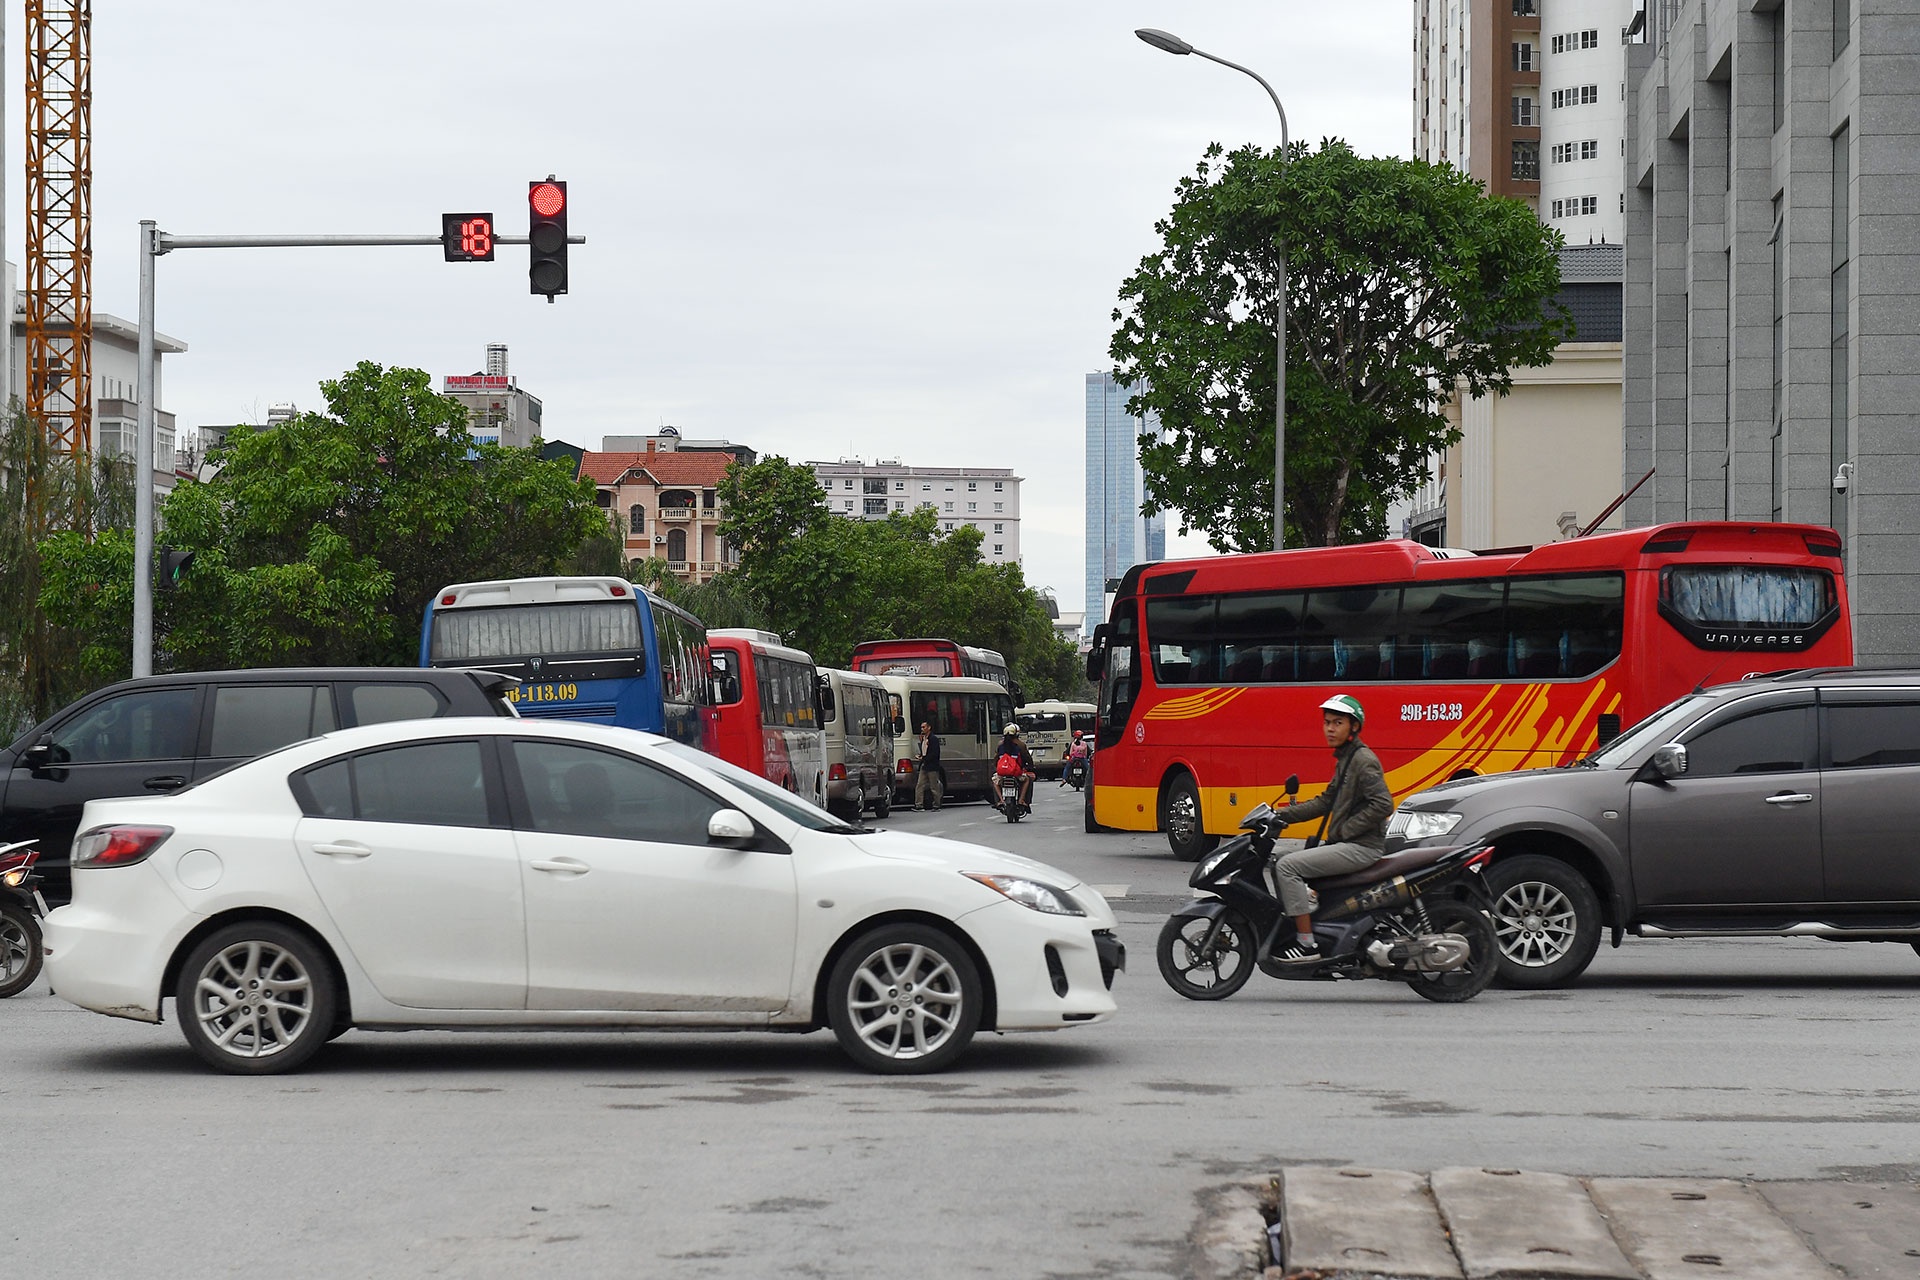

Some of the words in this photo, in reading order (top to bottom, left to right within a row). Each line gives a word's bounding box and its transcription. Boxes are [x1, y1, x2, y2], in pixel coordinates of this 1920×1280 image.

[462, 219, 490, 256] 18
[447, 376, 482, 384] APARTMENT
[484, 376, 495, 384] FOR
[1705, 633, 1803, 644] UNIVERSE
[504, 683, 578, 703] B-113.09
[1401, 703, 1463, 721] 29B-152.33
